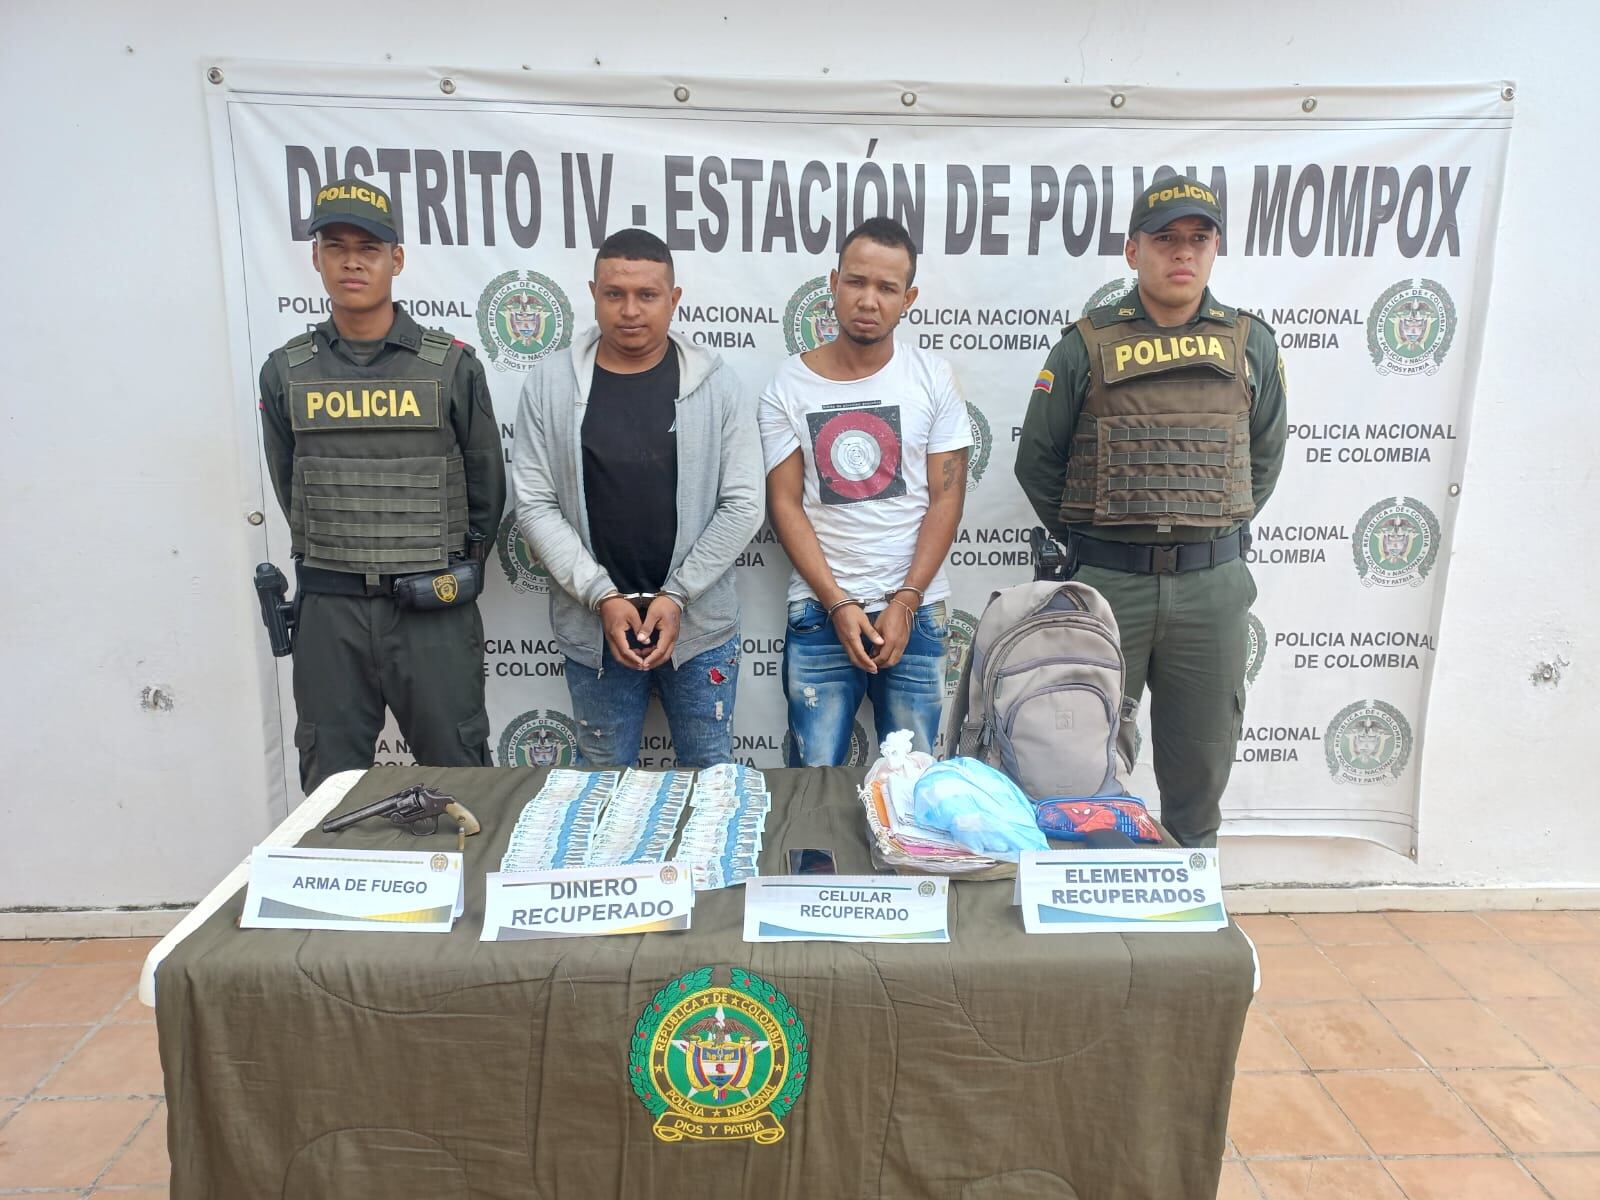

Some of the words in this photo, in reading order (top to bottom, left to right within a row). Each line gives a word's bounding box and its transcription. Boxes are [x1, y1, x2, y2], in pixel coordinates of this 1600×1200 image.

[285, 145, 541, 249] DTRITO
[561, 152, 613, 249] IV
[632, 205, 646, 225] -
[665, 138, 926, 256] ESTACIÓN
[945, 164, 1011, 256] DE
[1027, 164, 1227, 257] POLA
[1244, 164, 1471, 258] MOMPOX
[317, 185, 388, 213] POLICIA
[1148, 184, 1217, 208] POLICIA
[278, 296, 332, 314] POLI
[399, 300, 472, 318] IONAL
[489, 285, 512, 327] REPUBLICA
[538, 287, 562, 328] COLOMBIA
[678, 306, 779, 324] NACIONAL
[795, 291, 819, 332] REPUBLICA
[1378, 293, 1405, 333] REPUBLICA
[1430, 293, 1445, 333] COLOMBIA
[977, 308, 1075, 326] NACIONAL
[1271, 308, 1364, 325] NACIONAL
[495, 336, 519, 359] POLICIA
[528, 338, 560, 360] NACIONAL
[692, 331, 756, 349] OMBIA
[919, 334, 943, 350] DE
[949, 334, 1051, 350] COLOMBIA
[1279, 333, 1339, 349] OMBIA
[1115, 335, 1225, 372] POLICIA
[1380, 341, 1403, 362] POLICIA
[306, 389, 421, 419] POLICIA
[1286, 424, 1361, 440] POLICIA
[1365, 424, 1457, 440] NACIONAL
[1306, 447, 1332, 463] DE
[1338, 447, 1431, 463] COLOMBIA
[976, 528, 1033, 544] NACIO
[1257, 525, 1349, 541] NACIONAL
[1363, 510, 1389, 548] REPUBLICA
[1411, 510, 1429, 547] COLOMBIA
[950, 551, 1034, 566] COLOMBI
[1246, 548, 1326, 564] OLOMBIA
[513, 560, 537, 581] POLICIA
[742, 638, 785, 654] OLIC
[1274, 632, 1345, 647] POLICIA
[1350, 631, 1435, 651] NACIONAL
[496, 662, 564, 677] COLOM
[753, 661, 777, 676] DE
[1294, 654, 1319, 669] DE
[1324, 653, 1419, 669] COLOMBIA
[509, 723, 532, 760] REPUBLICA
[733, 735, 778, 750] ONAL
[1242, 727, 1321, 741] ACIONAL
[1236, 748, 1298, 762] OMBIA
[292, 876, 341, 890] ARMA
[345, 878, 367, 891] DE
[371, 879, 428, 894] FUEGO
[1065, 868, 1189, 884] ELEMENTOS
[550, 877, 638, 900] DINERO
[819, 890, 892, 904] CELULAR
[1051, 888, 1206, 905] RECUPERADOS
[511, 899, 674, 926] RECUPERADO
[800, 904, 909, 921] RECUPERADO
[656, 1001, 701, 1052] REPUBLICA
[713, 992, 728, 1004] DE
[740, 1000, 783, 1051] COLOMBIA
[666, 1089, 704, 1117] POLICIA
[727, 1085, 777, 1117] NACIONAL
[674, 1119, 703, 1135] DIOS
[709, 1125, 718, 1135] Y
[724, 1120, 764, 1135] PATRIA
